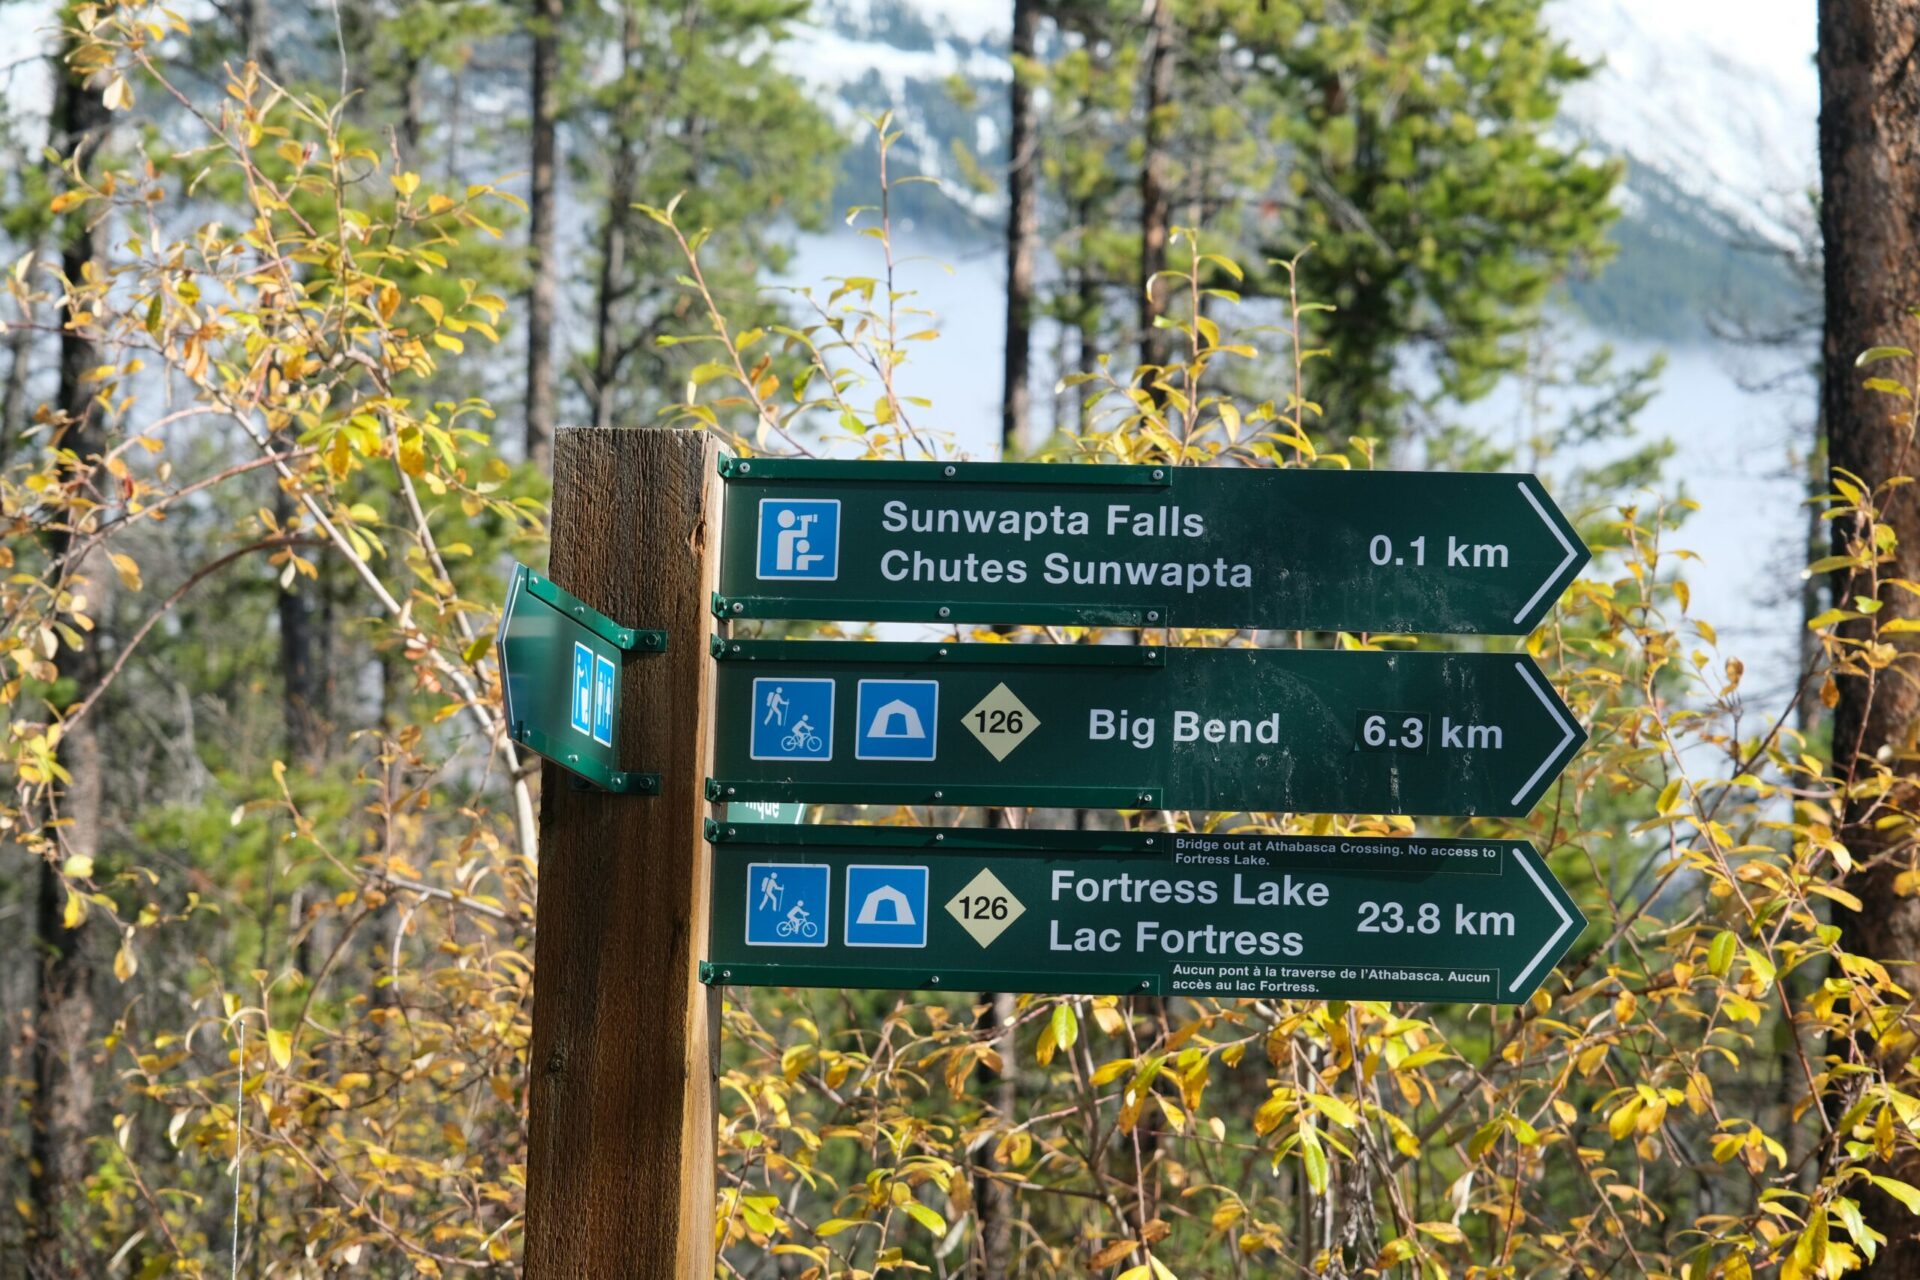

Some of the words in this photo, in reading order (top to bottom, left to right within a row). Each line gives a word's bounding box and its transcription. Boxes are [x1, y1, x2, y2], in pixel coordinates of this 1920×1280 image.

[882, 500, 1089, 541] Sunwapta
[1107, 505, 1204, 537] Falls
[1369, 534, 1425, 566] 0.1
[1447, 535, 1509, 568] km
[880, 549, 1028, 584] Chutes
[1043, 552, 1252, 593] Sunwapta
[974, 710, 1024, 735] 126
[1089, 708, 1155, 748] Big
[1173, 710, 1280, 745] Bend
[1363, 715, 1424, 748] 6.3
[1441, 716, 1503, 749] km
[1175, 838, 1219, 852] Bridge
[1223, 840, 1245, 851] out
[1248, 841, 1262, 851] at
[1265, 841, 1336, 853] Athabasca
[1340, 842, 1404, 857] Crossing.
[1408, 844, 1427, 856] No
[1431, 847, 1479, 858] access
[1483, 847, 1496, 858] to
[1175, 853, 1230, 865] Fortress
[1234, 854, 1270, 866] Lake.
[1051, 869, 1218, 905] Fortress
[1233, 873, 1330, 907] Lake
[958, 895, 1008, 920] 126
[1357, 901, 1441, 935] 23.8
[1455, 903, 1515, 936] km
[1049, 919, 1121, 953] Lac
[1136, 921, 1304, 957] Fortress
[1172, 963, 1215, 975] Aucun
[1218, 965, 1250, 978] pont
[1252, 965, 1261, 977] à
[1265, 966, 1277, 977] la
[1280, 967, 1336, 979] traverse
[1339, 968, 1357, 979] de
[1447, 971, 1491, 983] Aucun
[1172, 979, 1212, 990] accès
[1215, 981, 1232, 991] au
[1235, 979, 1256, 992] lac
[1259, 980, 1320, 993] Fortress.
